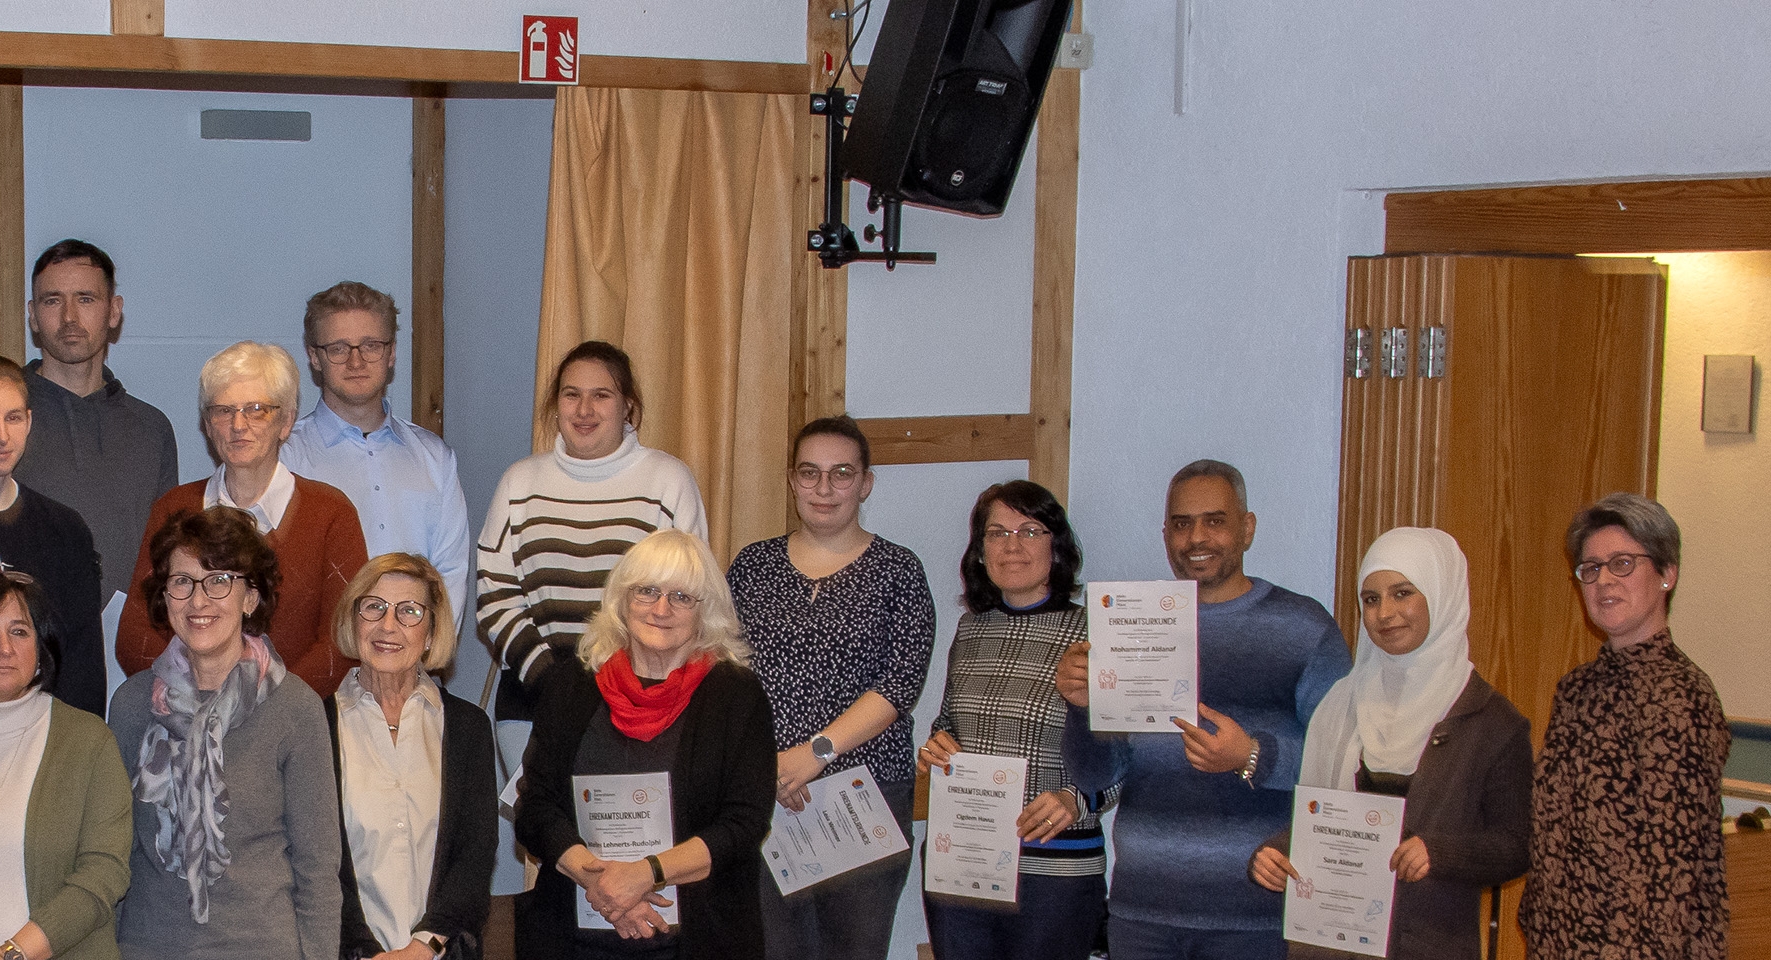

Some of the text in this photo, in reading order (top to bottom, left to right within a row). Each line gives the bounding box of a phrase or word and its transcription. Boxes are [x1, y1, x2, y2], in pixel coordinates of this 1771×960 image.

[1108, 617, 1177, 626] EHRENAMTSURKUNDE
[947, 785, 1007, 799] EHRENAMTSURKUNDE
[589, 810, 651, 821] EHRENAMTSURKUNDE
[1313, 826, 1380, 842] EHRENAMTSURKUNDE
